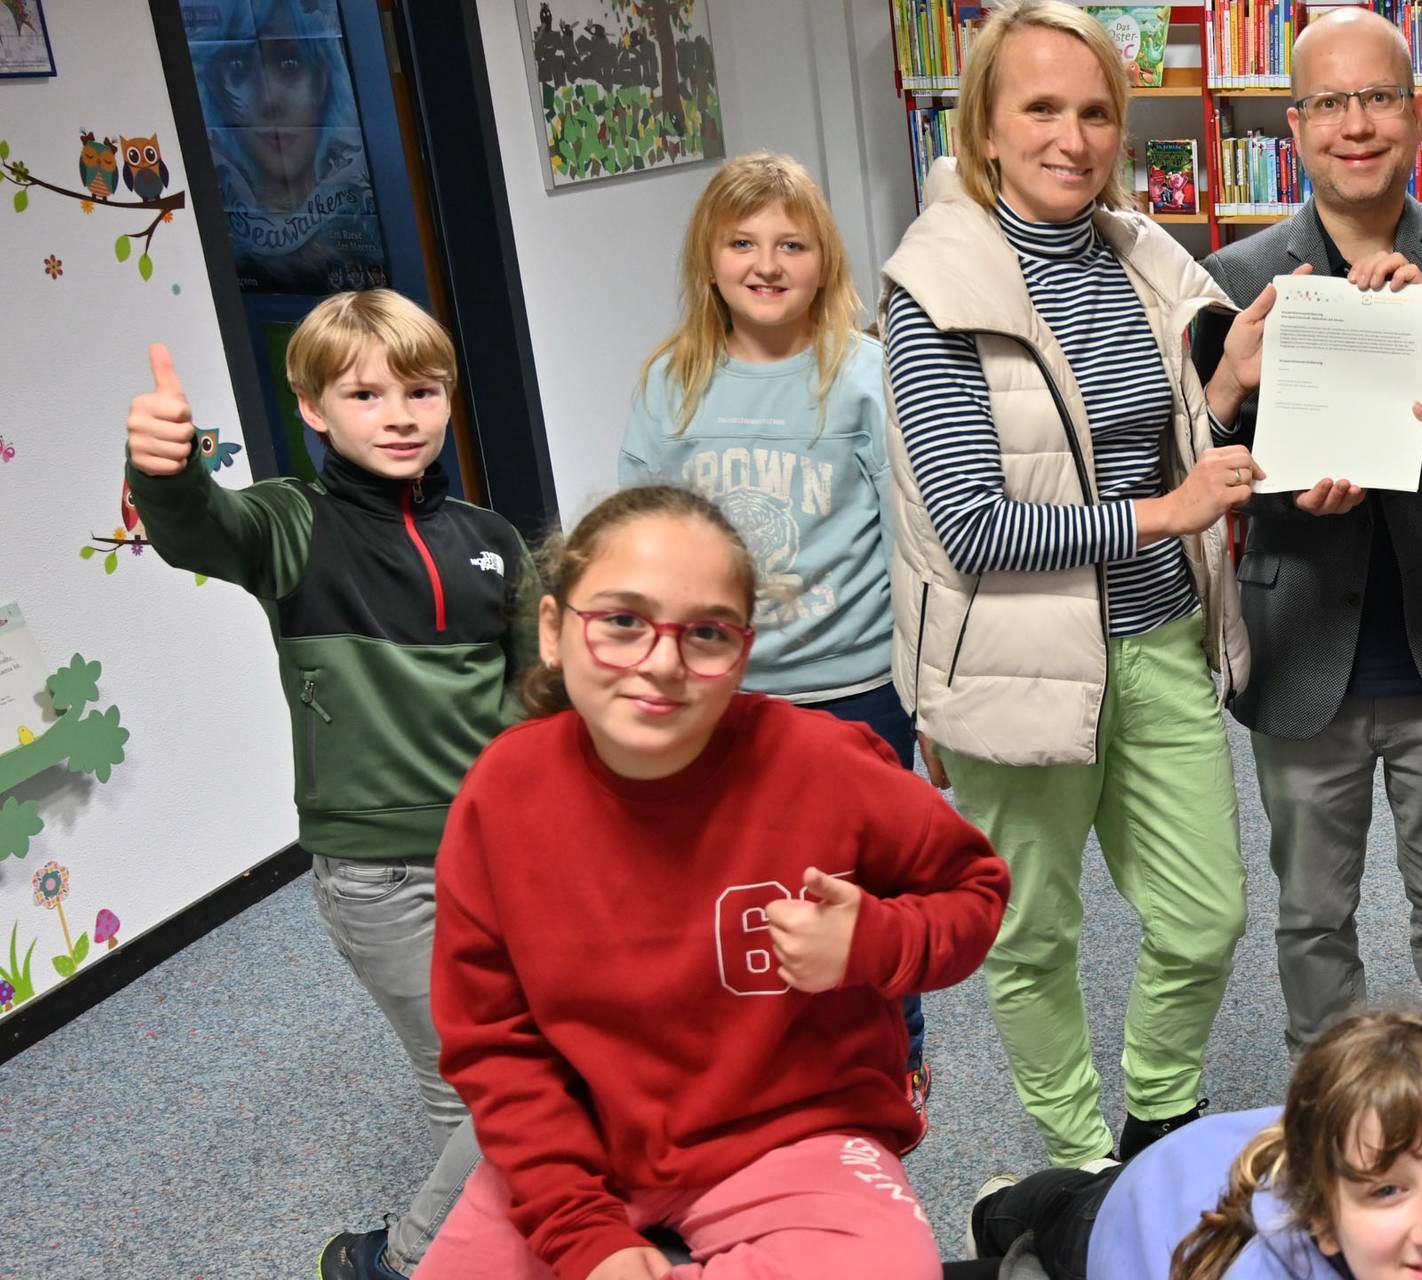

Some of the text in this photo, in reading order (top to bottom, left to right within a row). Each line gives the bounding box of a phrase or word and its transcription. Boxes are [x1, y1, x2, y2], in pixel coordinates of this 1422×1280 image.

[1116, 23, 1130, 31] Das
[1111, 30, 1138, 42] ster-
[1119, 44, 1136, 59] C
[227, 190, 357, 249] Seawalkers
